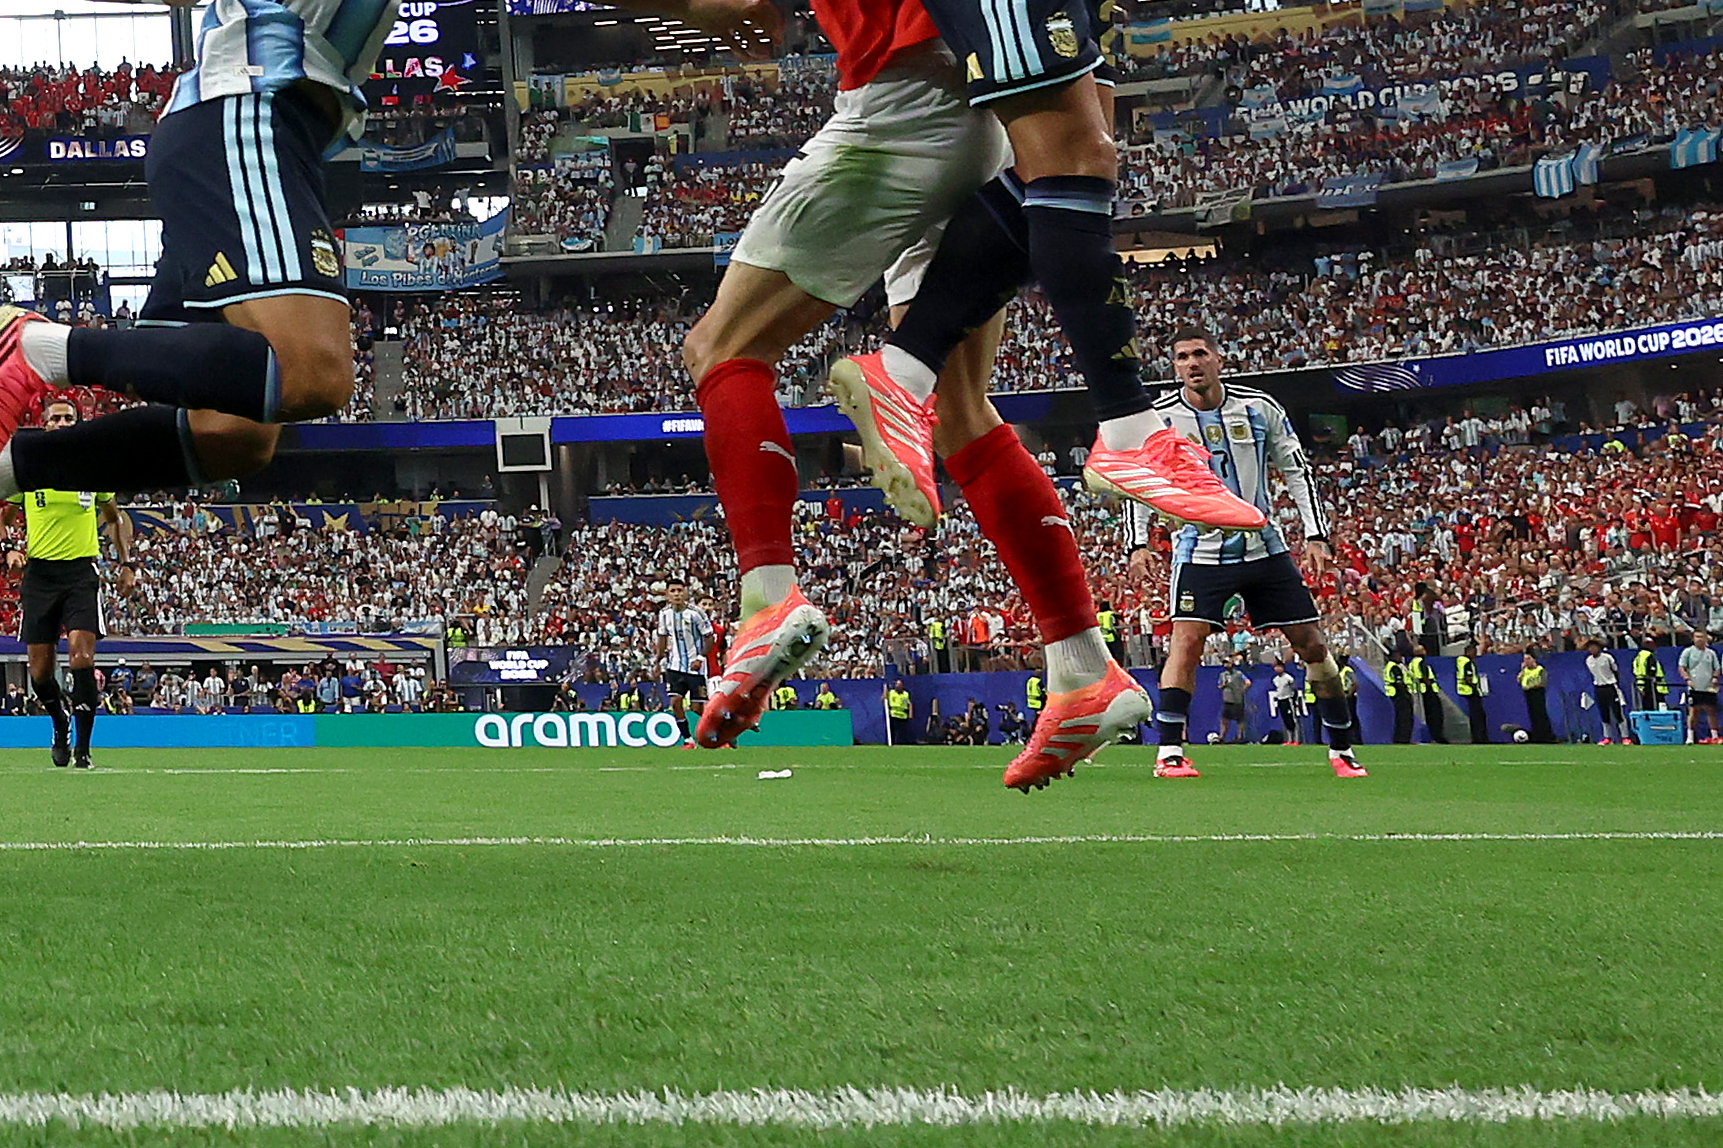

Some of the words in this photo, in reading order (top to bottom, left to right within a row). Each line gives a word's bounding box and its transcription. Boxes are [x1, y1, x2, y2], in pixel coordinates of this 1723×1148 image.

[398, 2, 437, 17] CUP
[384, 19, 439, 44] 26
[49, 139, 147, 159] DALLAS
[1545, 345, 1579, 366] FIFA
[1579, 337, 1636, 361] WORLD
[1637, 332, 1670, 353] CUP
[475, 713, 680, 747] aramco
